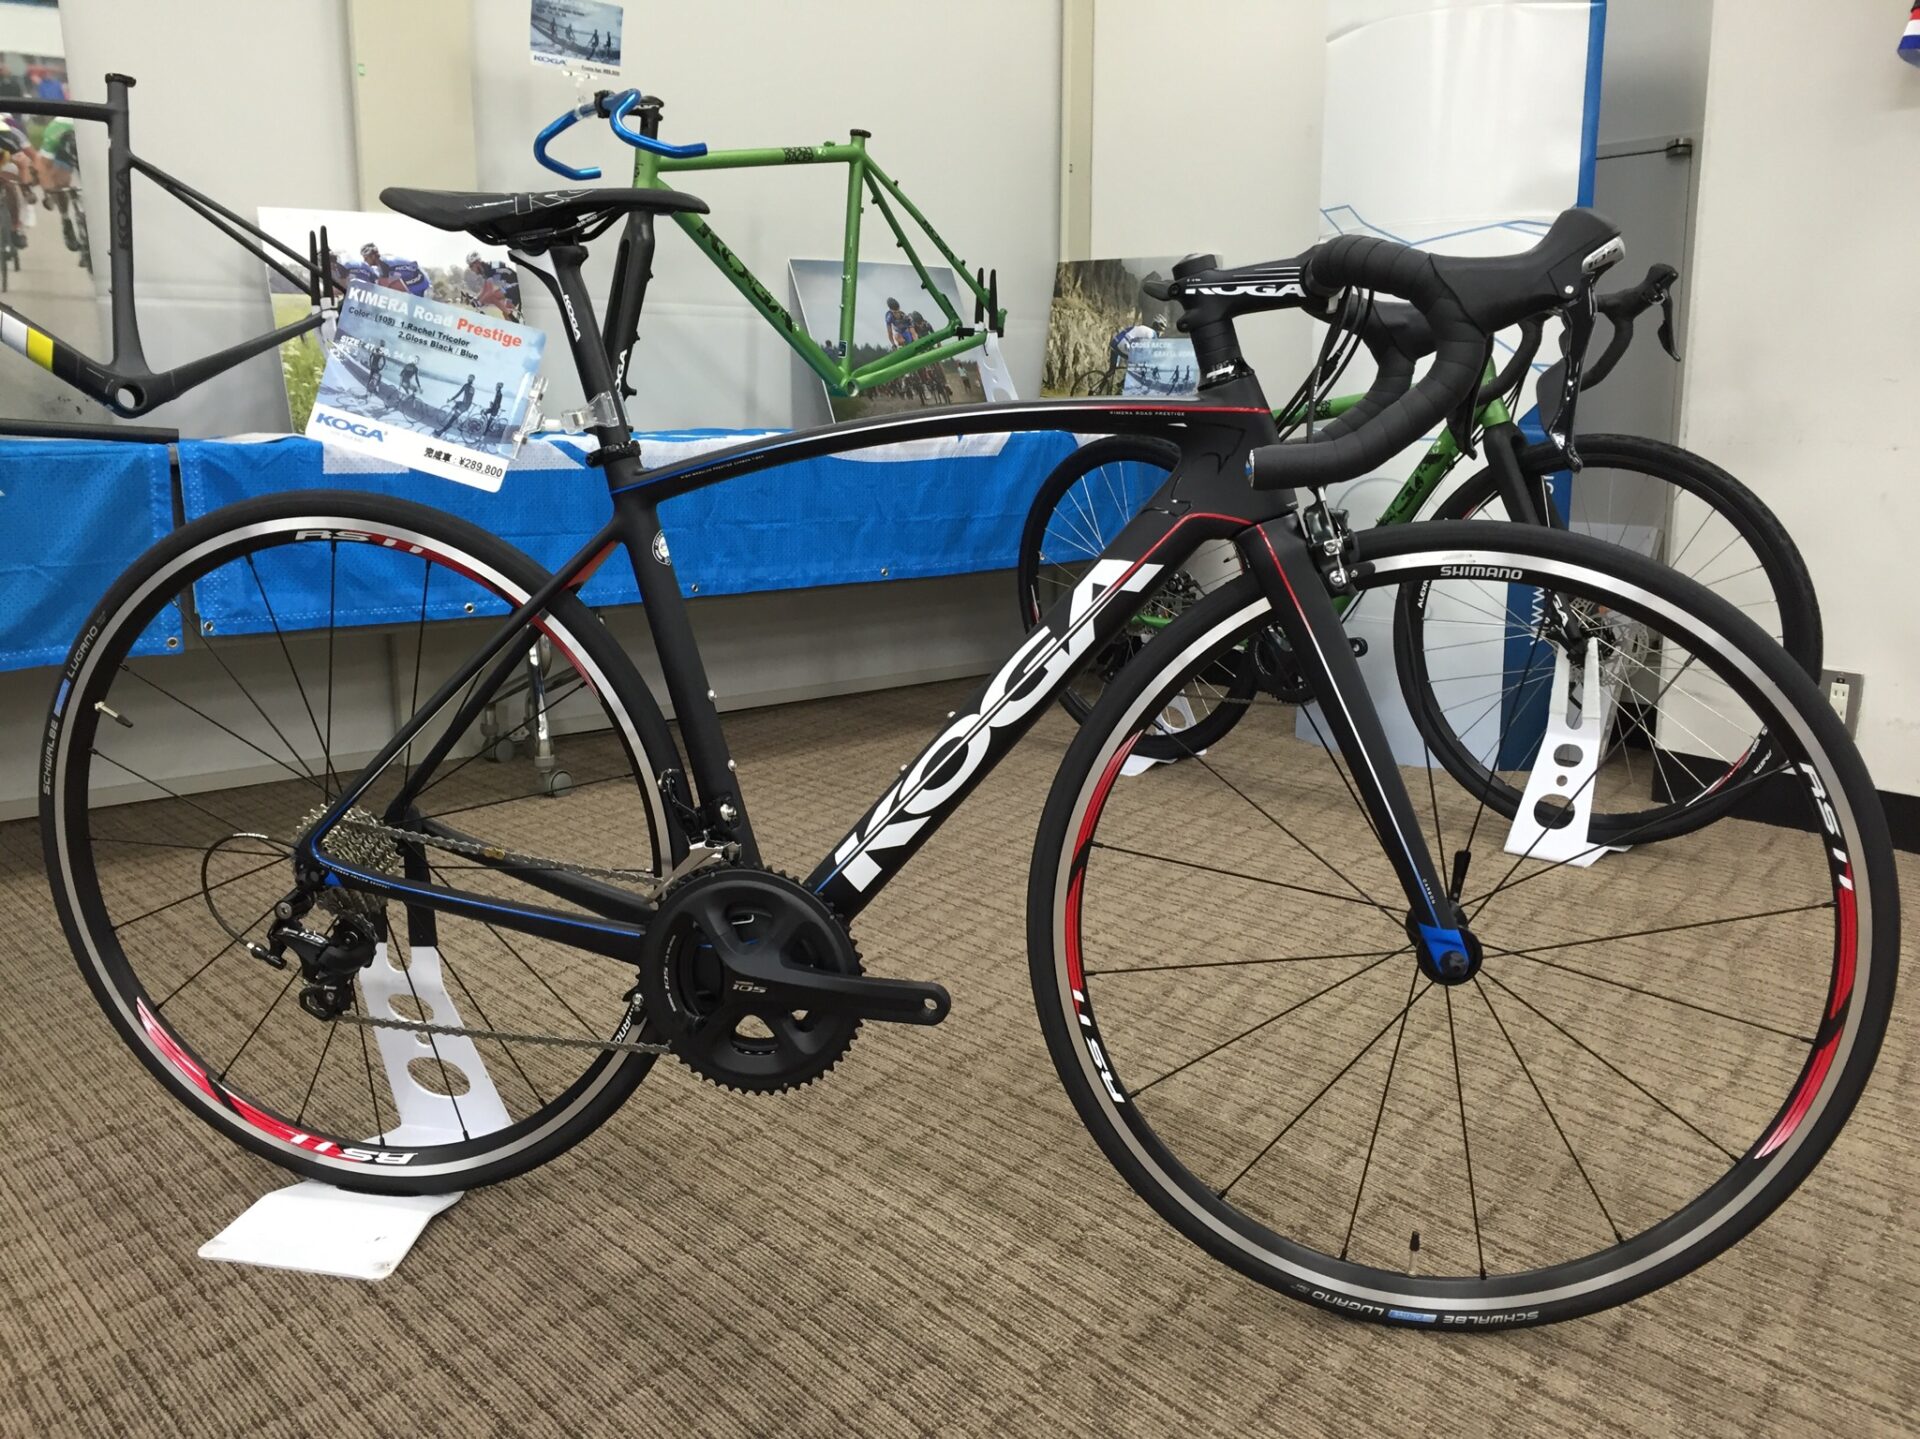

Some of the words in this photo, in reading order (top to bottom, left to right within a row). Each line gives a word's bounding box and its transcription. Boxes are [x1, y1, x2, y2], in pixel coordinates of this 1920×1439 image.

[348, 286, 409, 316] KIMERA
[412, 307, 455, 328] Road
[456, 317, 523, 348] Prestige
[563, 293, 581, 342] KOGA
[398, 330, 428, 347] 2.Gloss
[429, 339, 454, 354] Black
[459, 348, 480, 361] Blue
[437, 331, 471, 348] Tricolor
[614, 348, 628, 393] OGA
[315, 412, 385, 443] KOGA
[458, 456, 504, 479] ¥289,800
[1440, 565, 1523, 581] SHIMANO
[66, 625, 99, 679] LUGANO
[834, 558, 1164, 893] KOGA
[42, 719, 60, 796] SCHWALBE
[731, 983, 769, 994] 105
[1311, 1289, 1385, 1317] LUGANO
[1442, 1310, 1540, 1325] SCHWALBE
